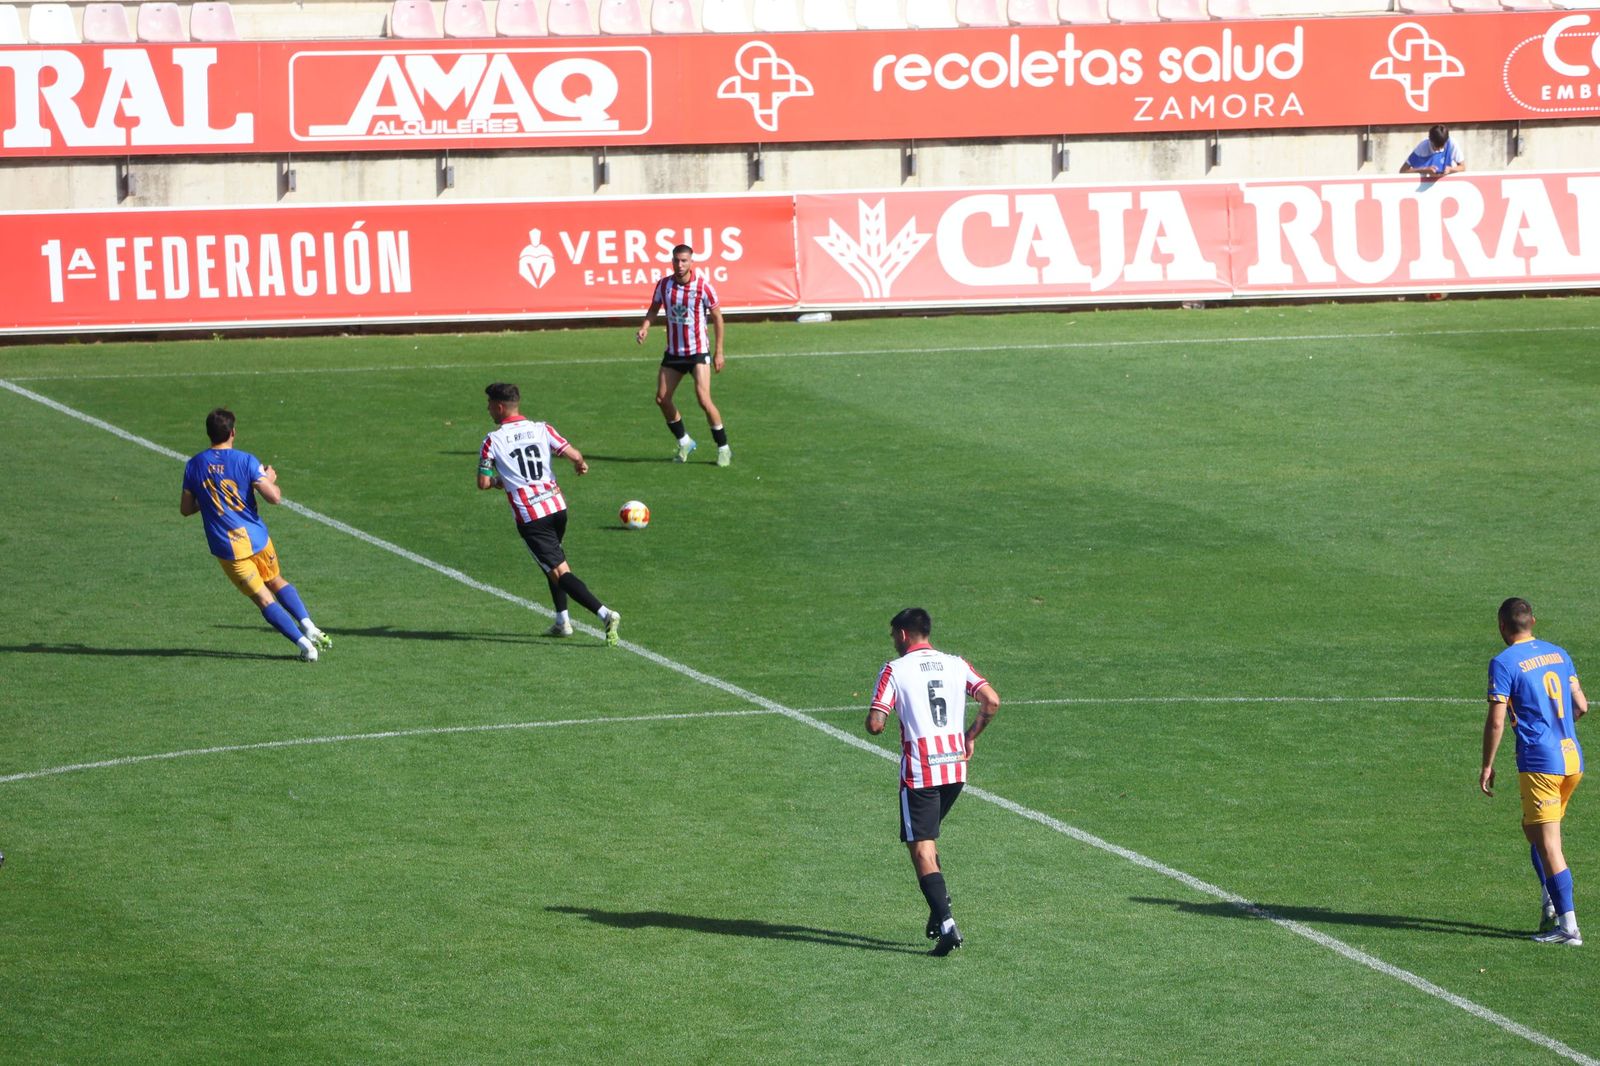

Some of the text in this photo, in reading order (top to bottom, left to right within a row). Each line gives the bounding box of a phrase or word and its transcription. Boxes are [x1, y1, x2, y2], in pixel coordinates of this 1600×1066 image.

[873, 25, 1304, 92] recoletas salud
[1542, 14, 1600, 77] C
[309, 53, 619, 136] AMAQ
[1133, 92, 1305, 121] ZAMORA
[1541, 83, 1600, 101] EMB
[372, 119, 519, 136] ALQUILERES
[106, 221, 412, 300] FEDERACIÓN
[558, 226, 744, 264] VERSUS
[936, 191, 1217, 291] CAJA
[584, 266, 729, 286] E-LEARNG
[927, 680, 948, 728] 6
[1542, 670, 1564, 719] 9
